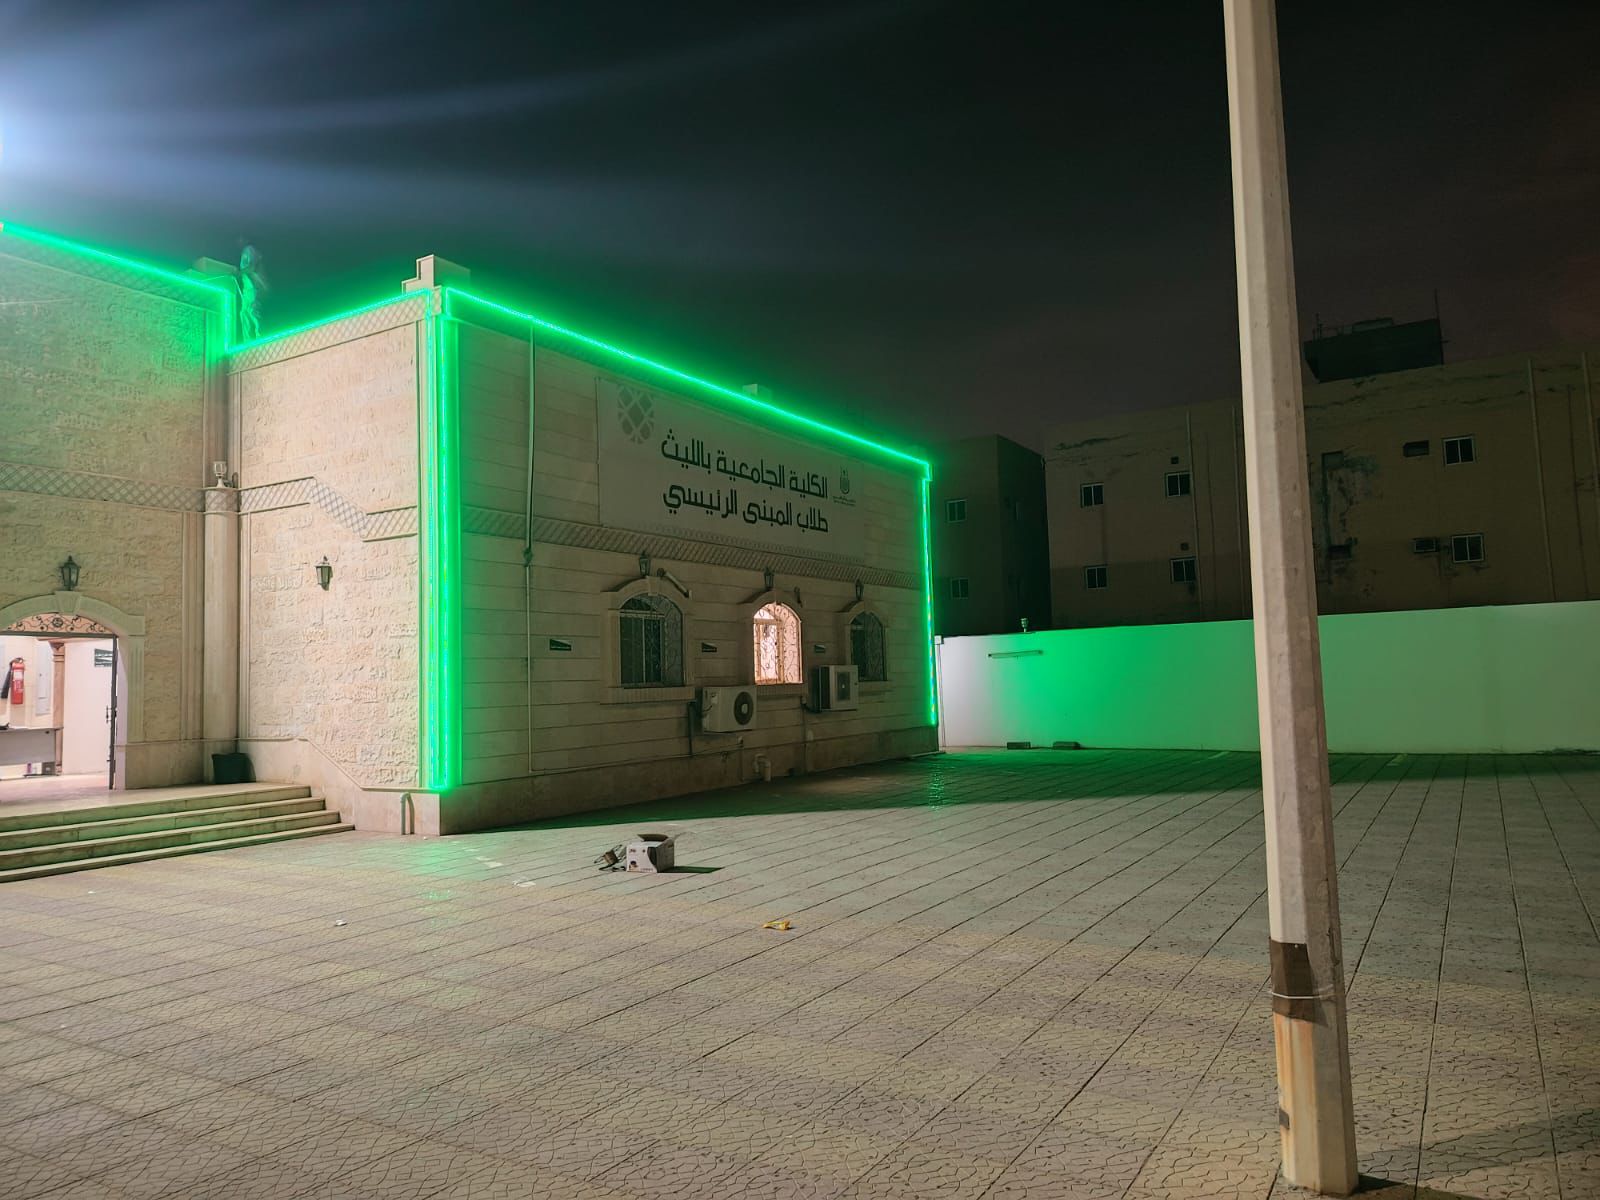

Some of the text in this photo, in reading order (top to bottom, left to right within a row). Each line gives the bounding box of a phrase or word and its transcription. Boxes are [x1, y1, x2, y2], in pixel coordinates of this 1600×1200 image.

[661, 428, 828, 499] الكلية الجامعية بالليث
[663, 485, 829, 532] طلاب المبنى الرئيسي
